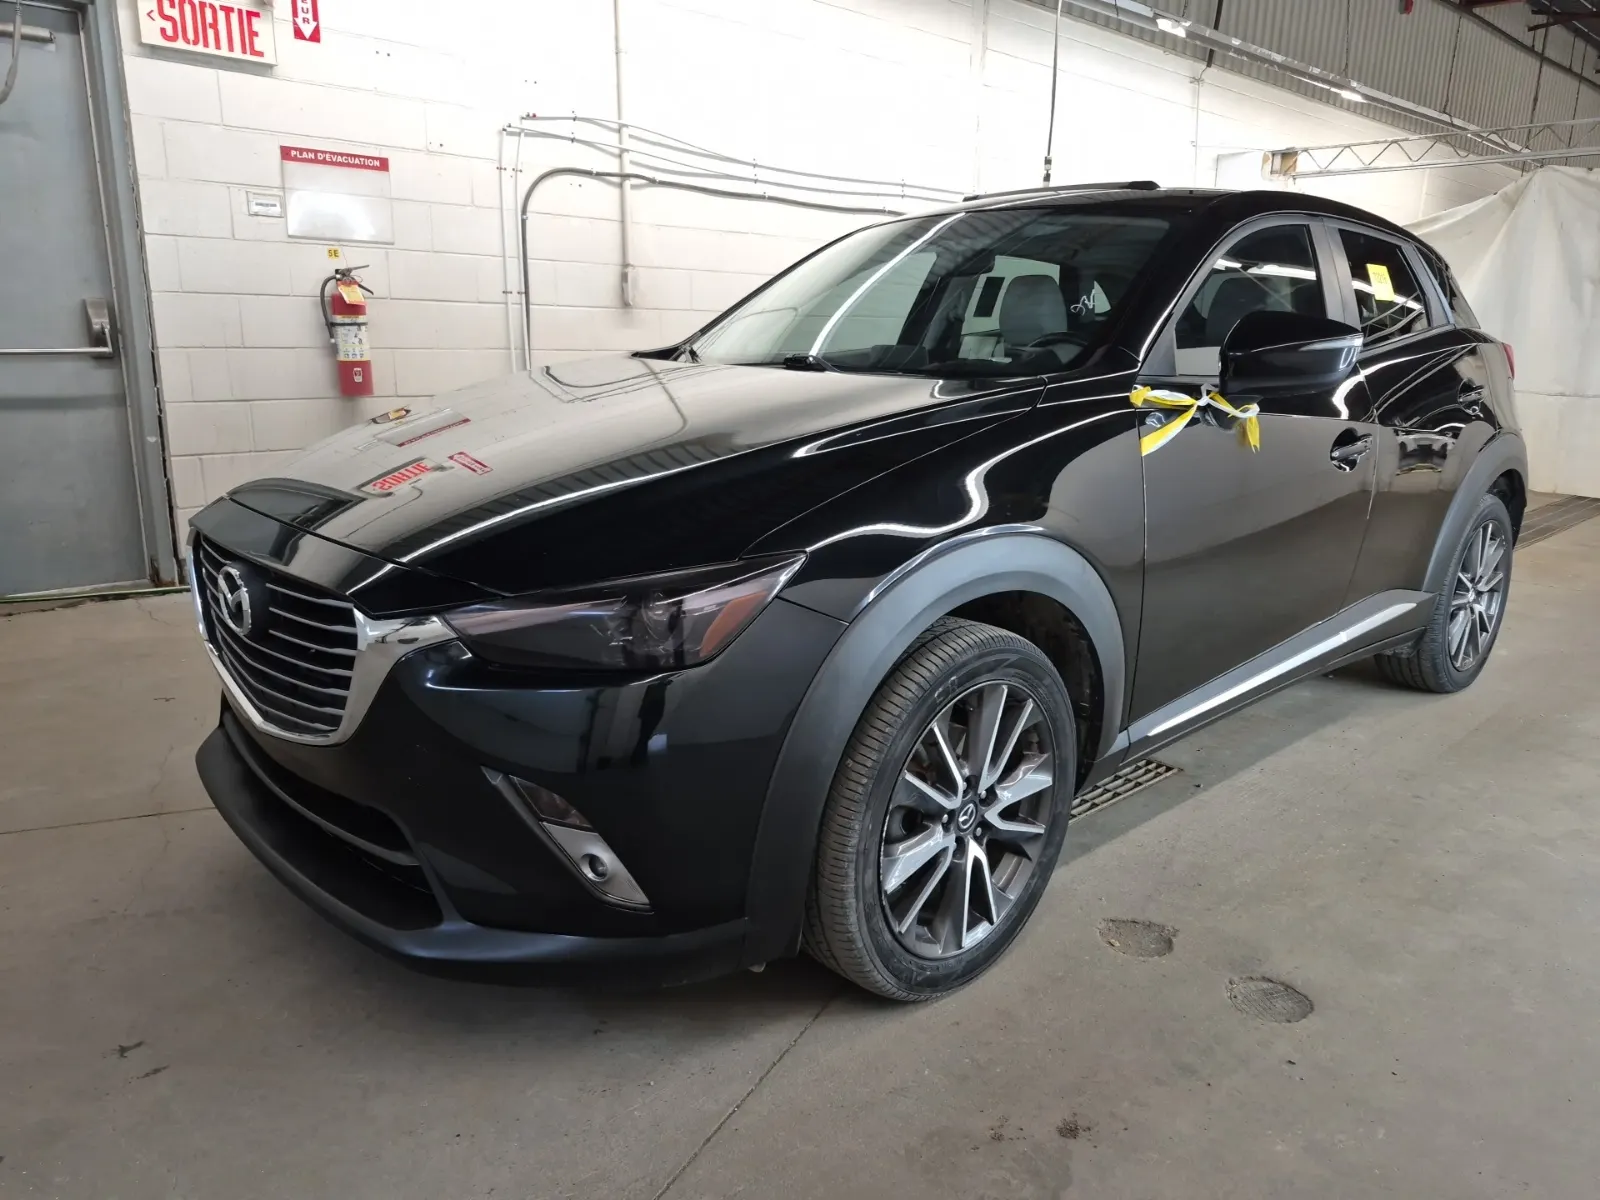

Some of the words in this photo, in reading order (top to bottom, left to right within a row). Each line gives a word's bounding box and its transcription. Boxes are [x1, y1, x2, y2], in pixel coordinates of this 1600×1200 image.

[157, 0, 264, 57] SORTIE
[290, 149, 315, 160] PLAN
[317, 152, 381, 167] D'ÉVACUATION
